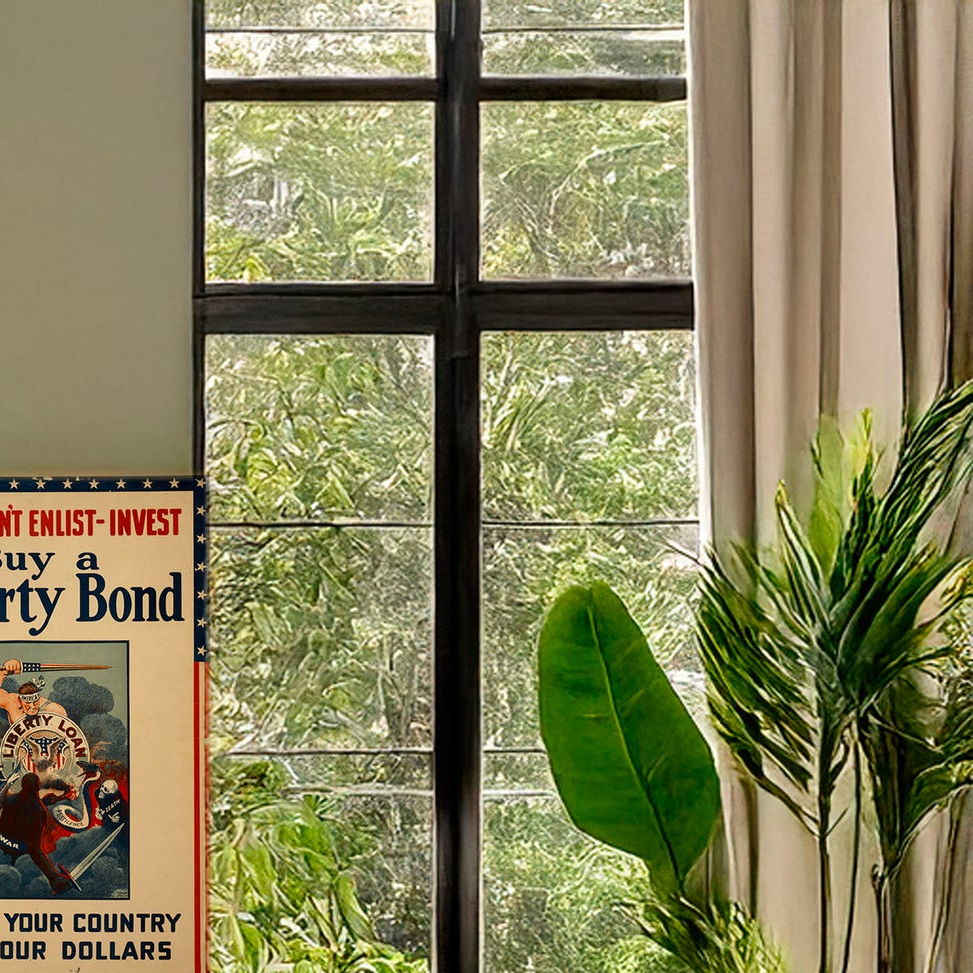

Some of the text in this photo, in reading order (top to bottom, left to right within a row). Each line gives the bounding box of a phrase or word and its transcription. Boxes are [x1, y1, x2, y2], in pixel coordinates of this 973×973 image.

[109, 508, 182, 536] INVEST
[76, 552, 100, 571] a
[75, 572, 186, 622] Bond
[3, 715, 86, 758] LIBERTY LOAN
[56, 808, 85, 828] PESTILENCE
[0, 834, 19, 850] WAR
[3, 913, 63, 933] YOUR
[73, 913, 182, 933] COUNTRY
[62, 941, 172, 960] DOLLARS
